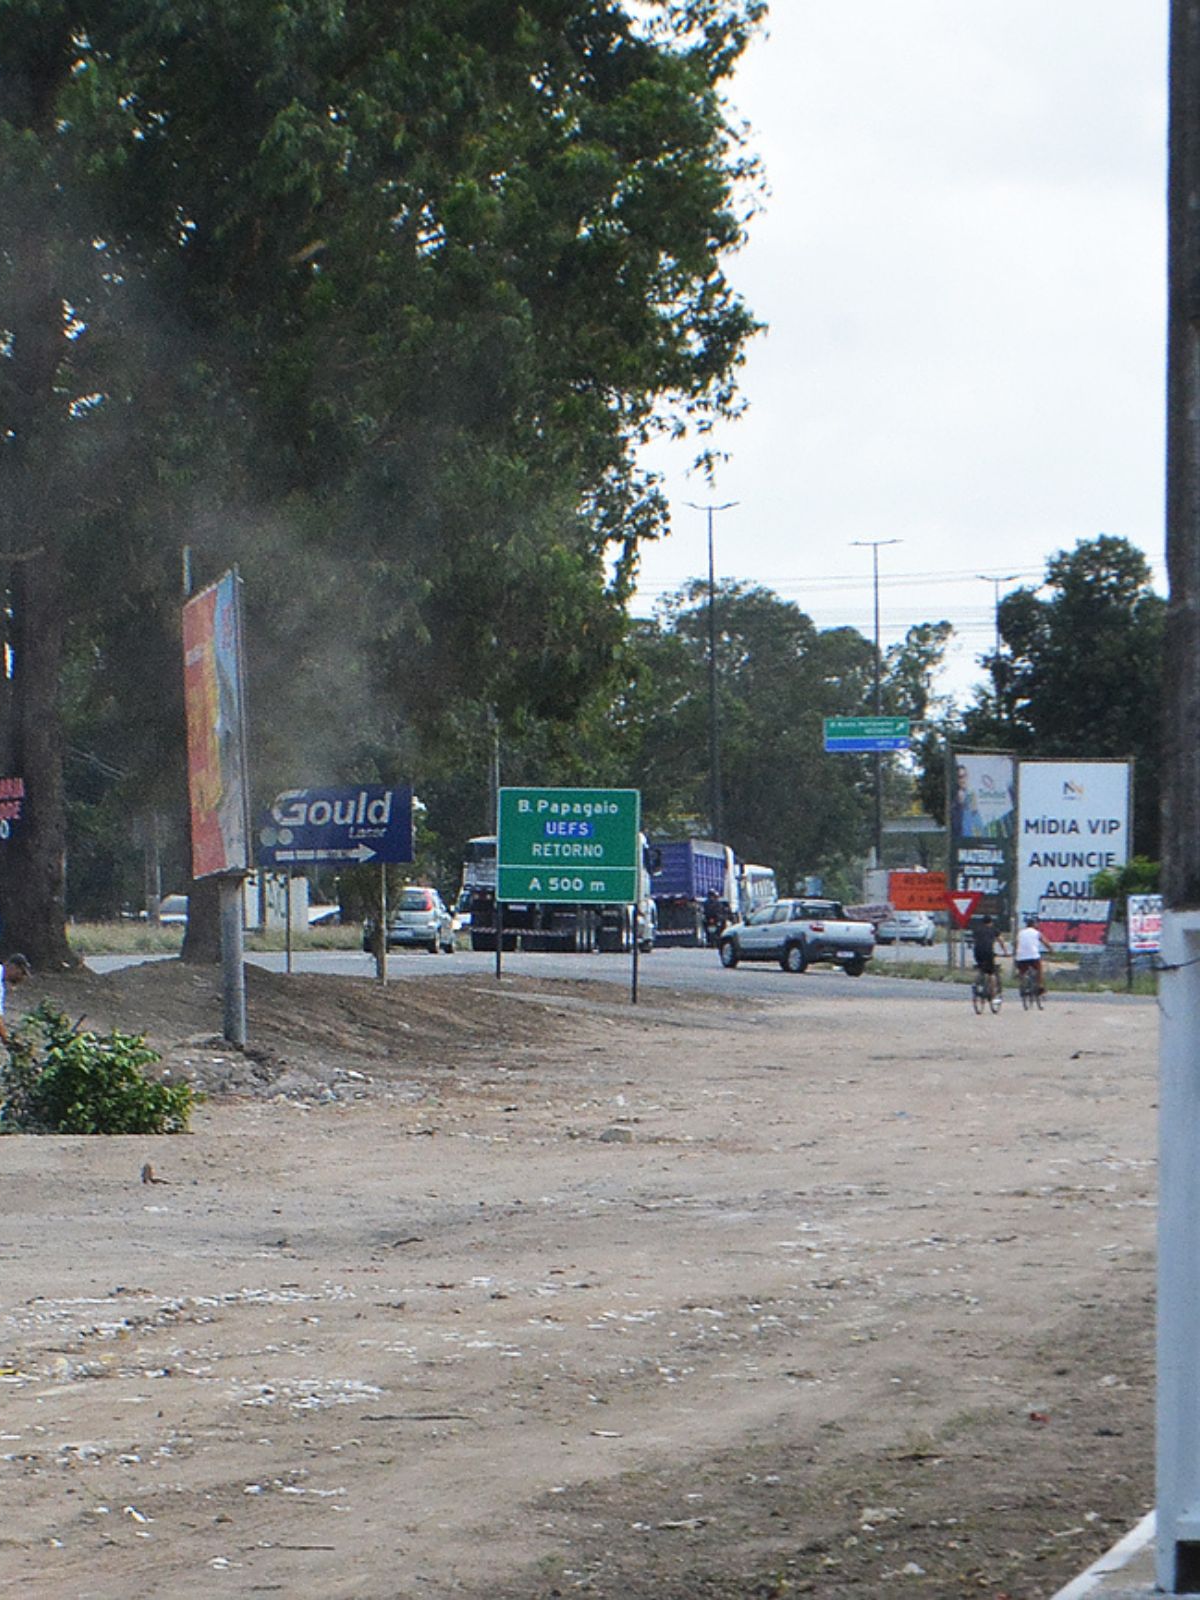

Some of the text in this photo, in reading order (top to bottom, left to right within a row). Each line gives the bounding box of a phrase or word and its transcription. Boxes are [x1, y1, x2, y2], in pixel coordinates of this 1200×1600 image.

[272, 789, 393, 827] Gould
[518, 799, 619, 817] B. Papagaio
[545, 822, 589, 835] UEFS
[1024, 815, 1121, 834] MÍDIA VIP
[532, 843, 604, 857] RETORNO
[1029, 852, 1116, 867] ANUNCIE
[529, 878, 605, 891] A 500 m
